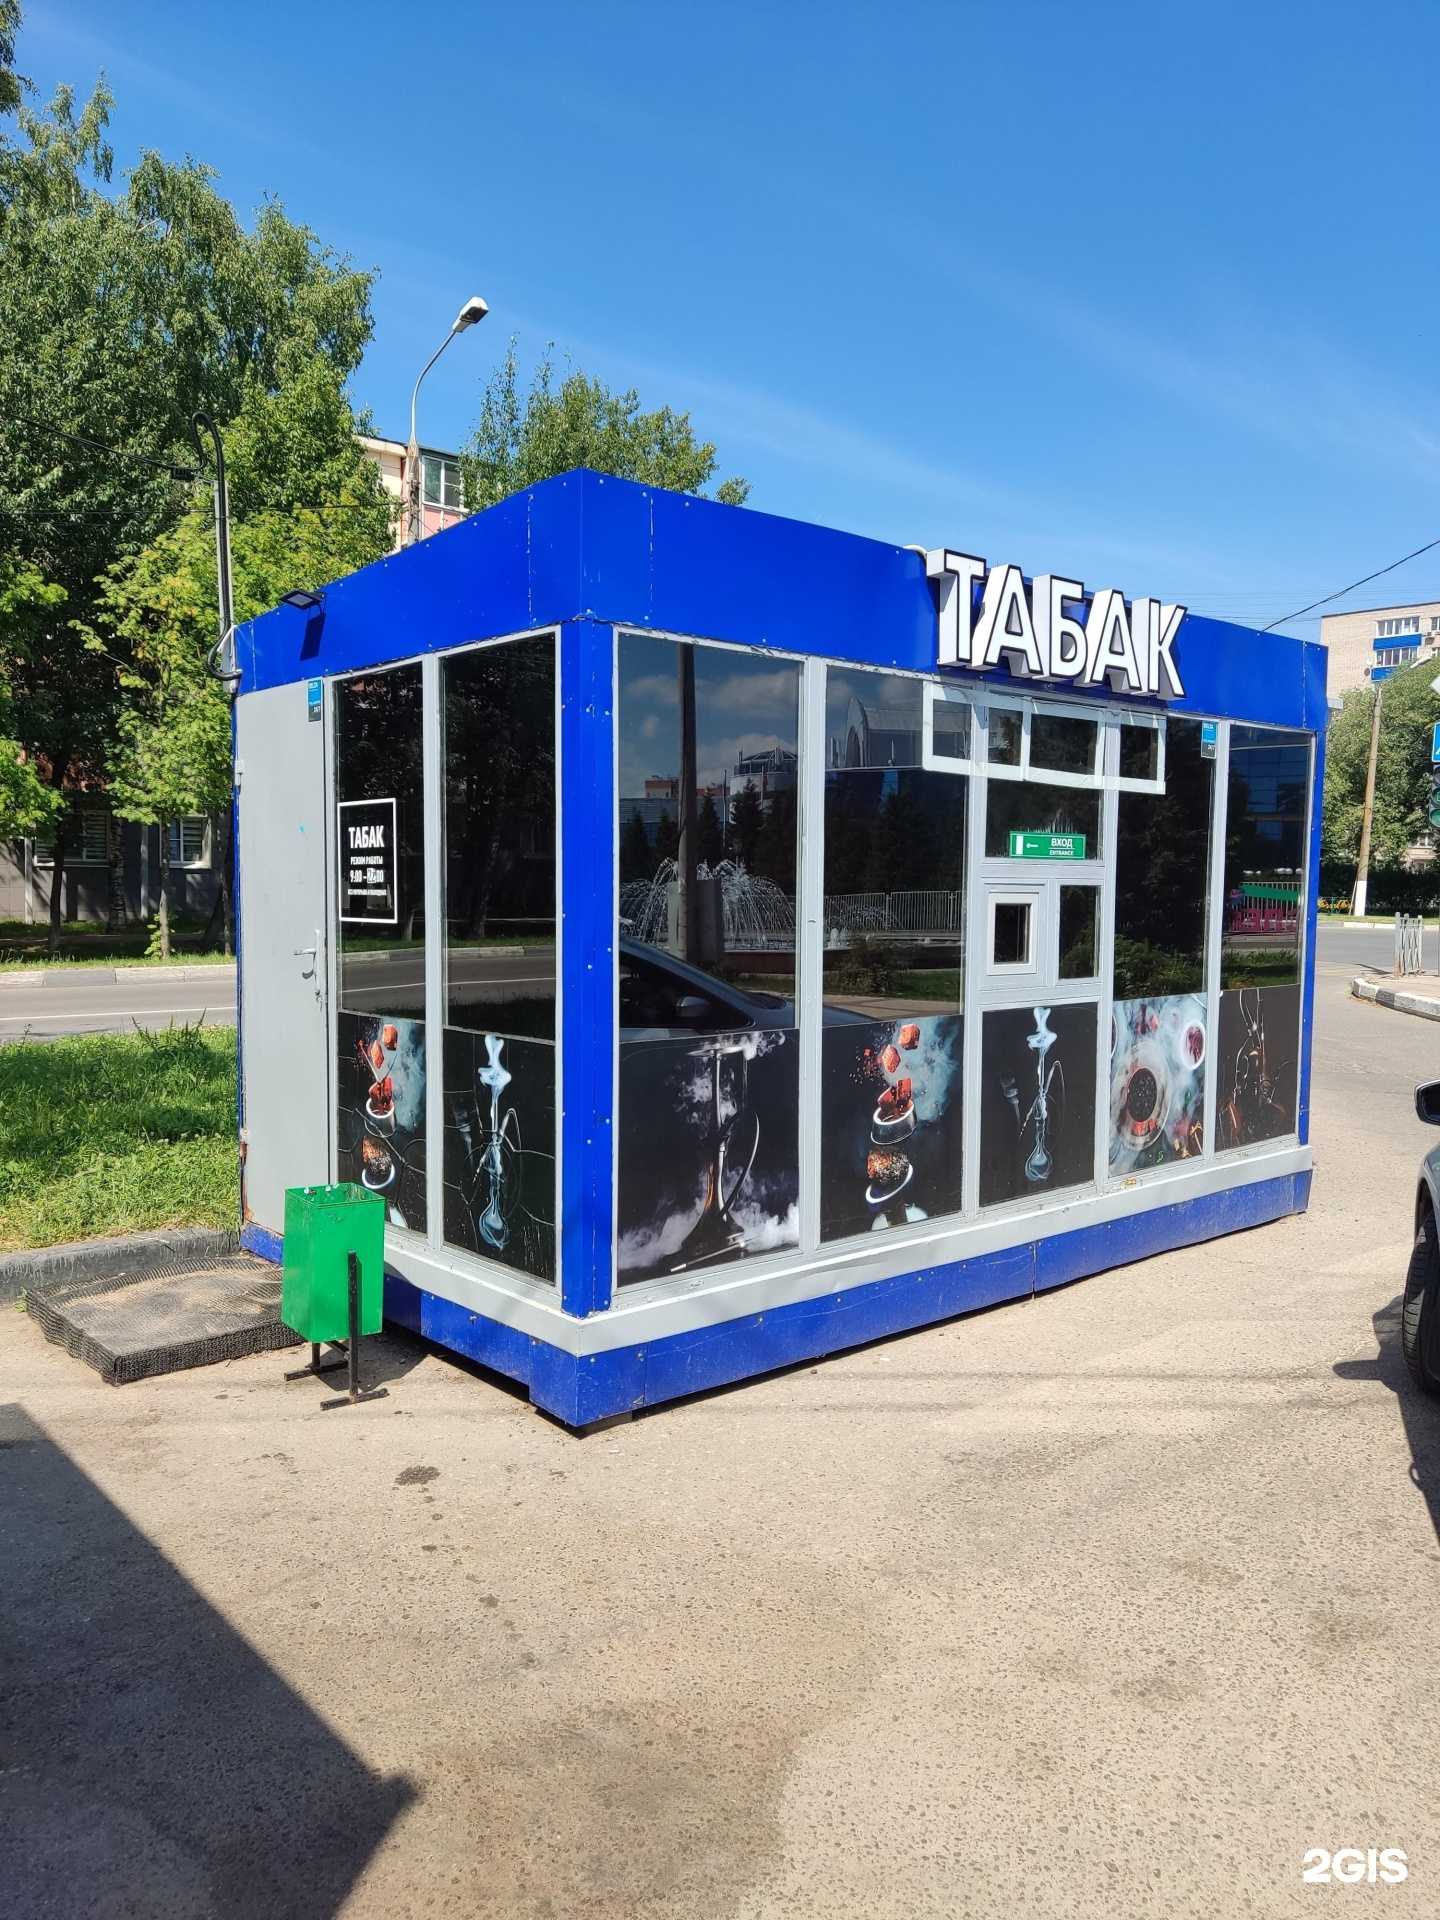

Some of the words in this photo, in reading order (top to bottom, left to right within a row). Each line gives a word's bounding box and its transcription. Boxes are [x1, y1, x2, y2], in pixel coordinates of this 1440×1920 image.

[927, 549, 1187, 700] ТАБАК
[348, 826, 384, 848] ТАБАК
[1051, 838, 1073, 849] ВХОД
